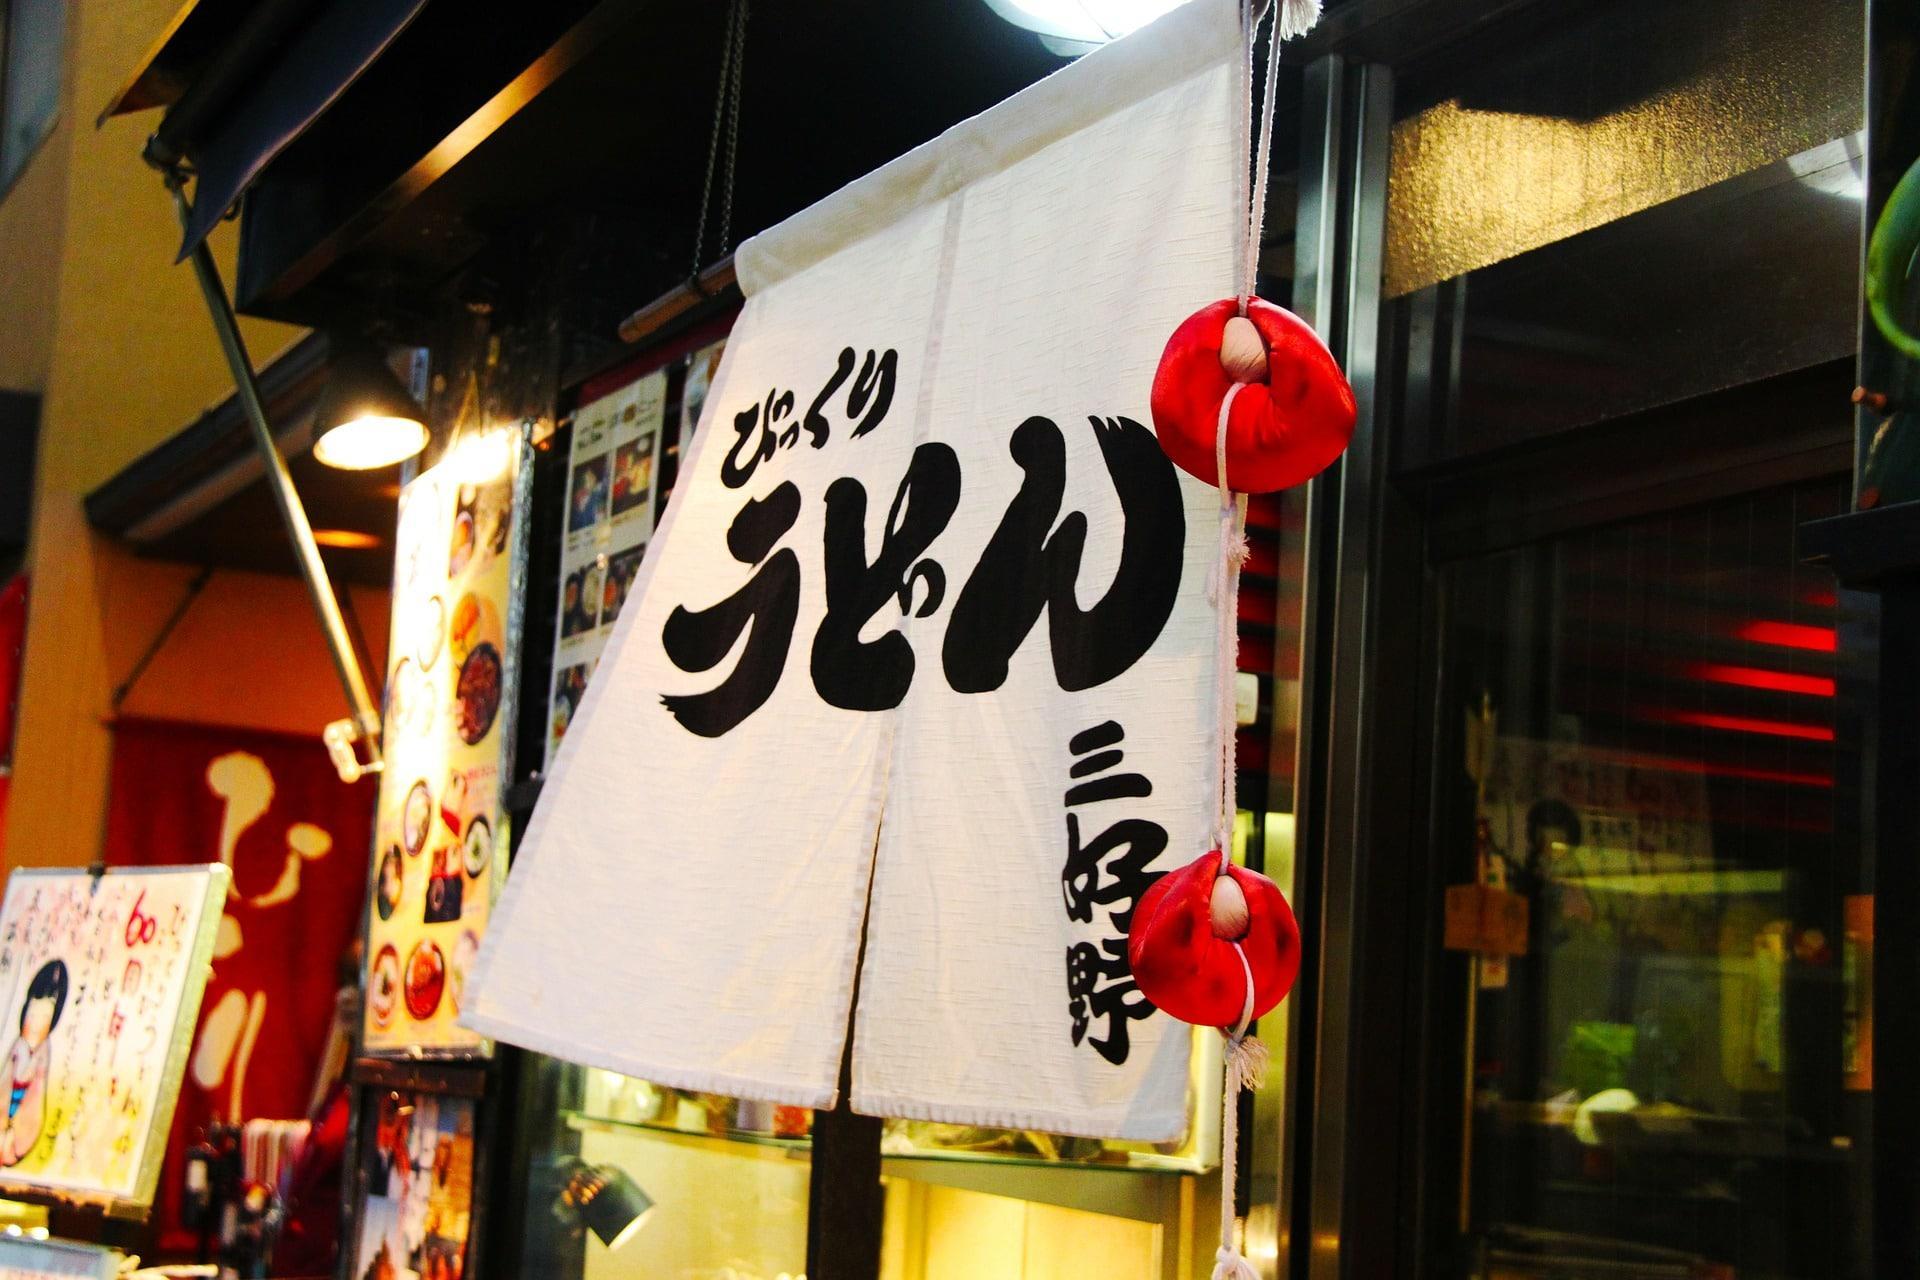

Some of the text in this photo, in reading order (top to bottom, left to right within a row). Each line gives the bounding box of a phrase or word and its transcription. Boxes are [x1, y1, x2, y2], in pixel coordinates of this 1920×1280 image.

[720, 346, 898, 489] びっくり
[658, 415, 1186, 738] うどん
